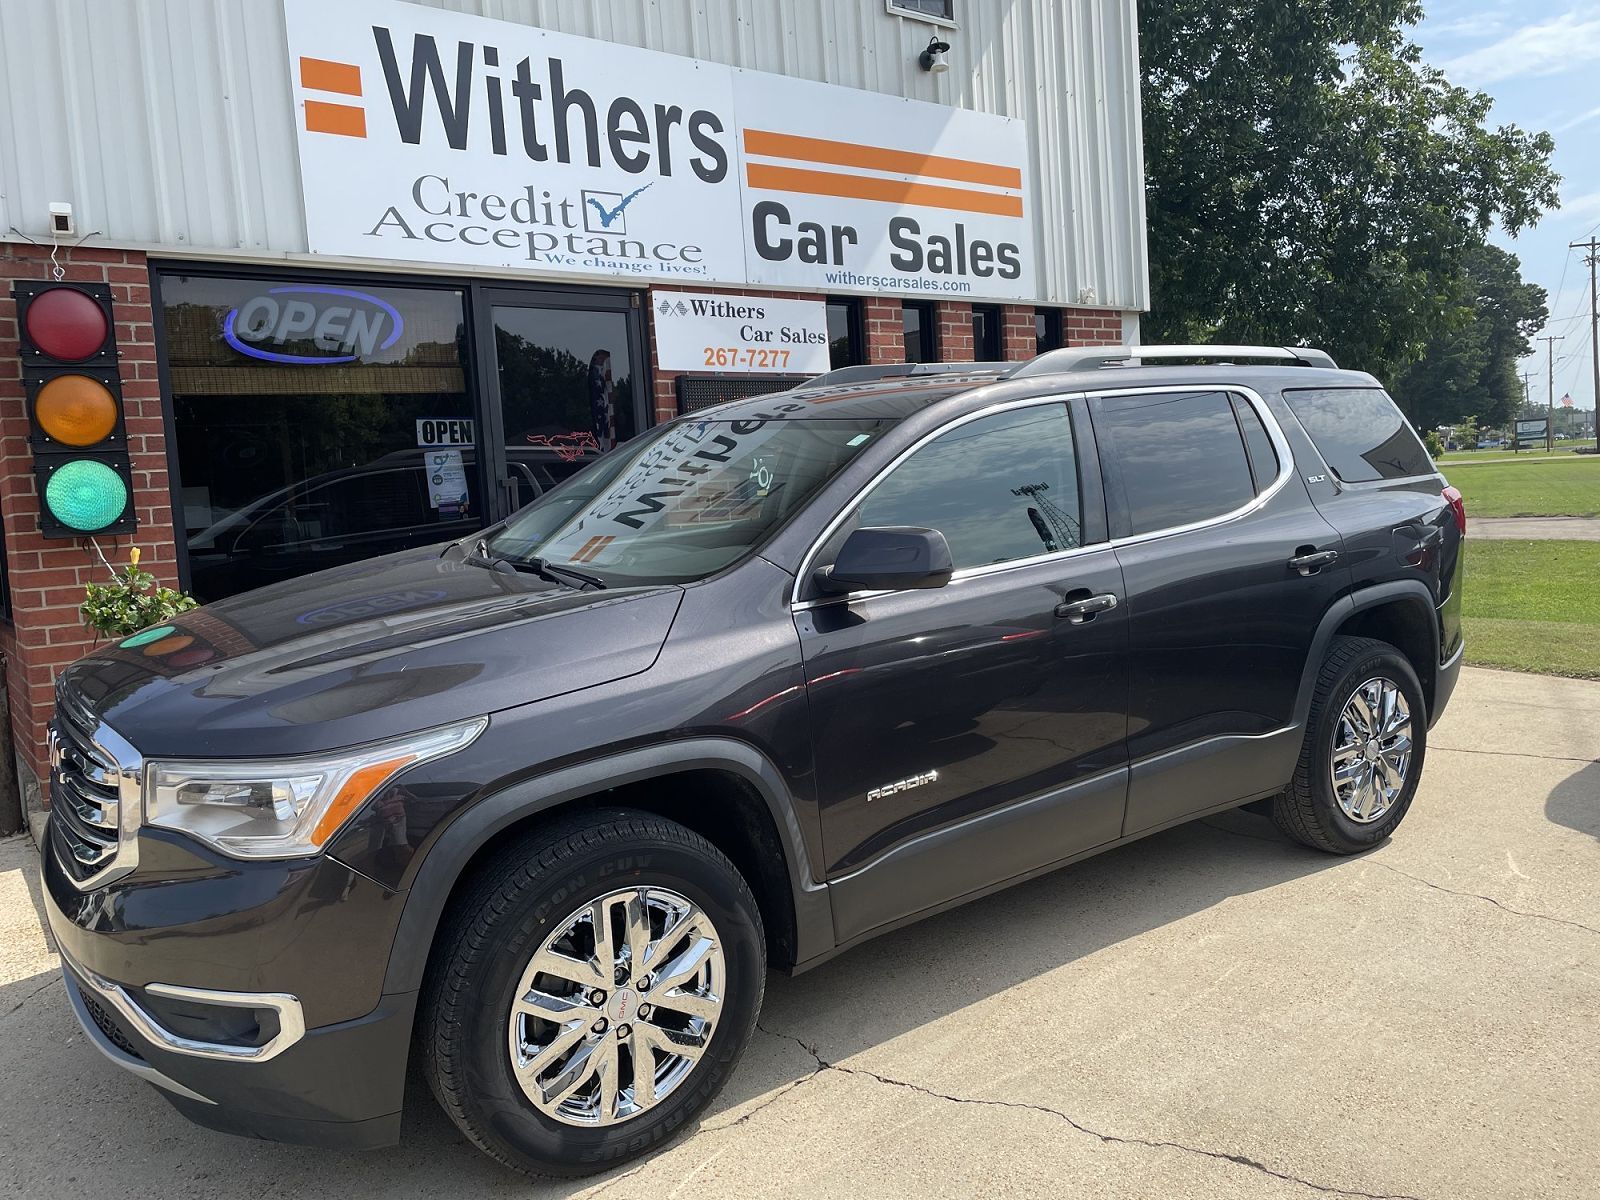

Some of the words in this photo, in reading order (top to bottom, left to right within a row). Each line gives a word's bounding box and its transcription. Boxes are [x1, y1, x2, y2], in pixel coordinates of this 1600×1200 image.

[371, 25, 728, 184] Withers
[411, 174, 578, 230] Credit
[363, 205, 703, 263] Acceptance
[752, 200, 858, 266] Car
[889, 215, 1021, 280] Sales
[544, 252, 576, 265] We
[583, 256, 653, 273] change
[659, 261, 707, 275] lives!
[825, 270, 971, 293] witherscarsales.com
[689, 298, 766, 320] Withers
[237, 296, 386, 356] OPEN
[739, 325, 774, 342] Car
[780, 326, 827, 345] Sales
[703, 347, 791, 369] 267-7277
[422, 420, 473, 444] OPEN
[1307, 474, 1326, 484] SLT
[867, 770, 938, 802] ACADIA
[618, 991, 629, 1019] GMC
